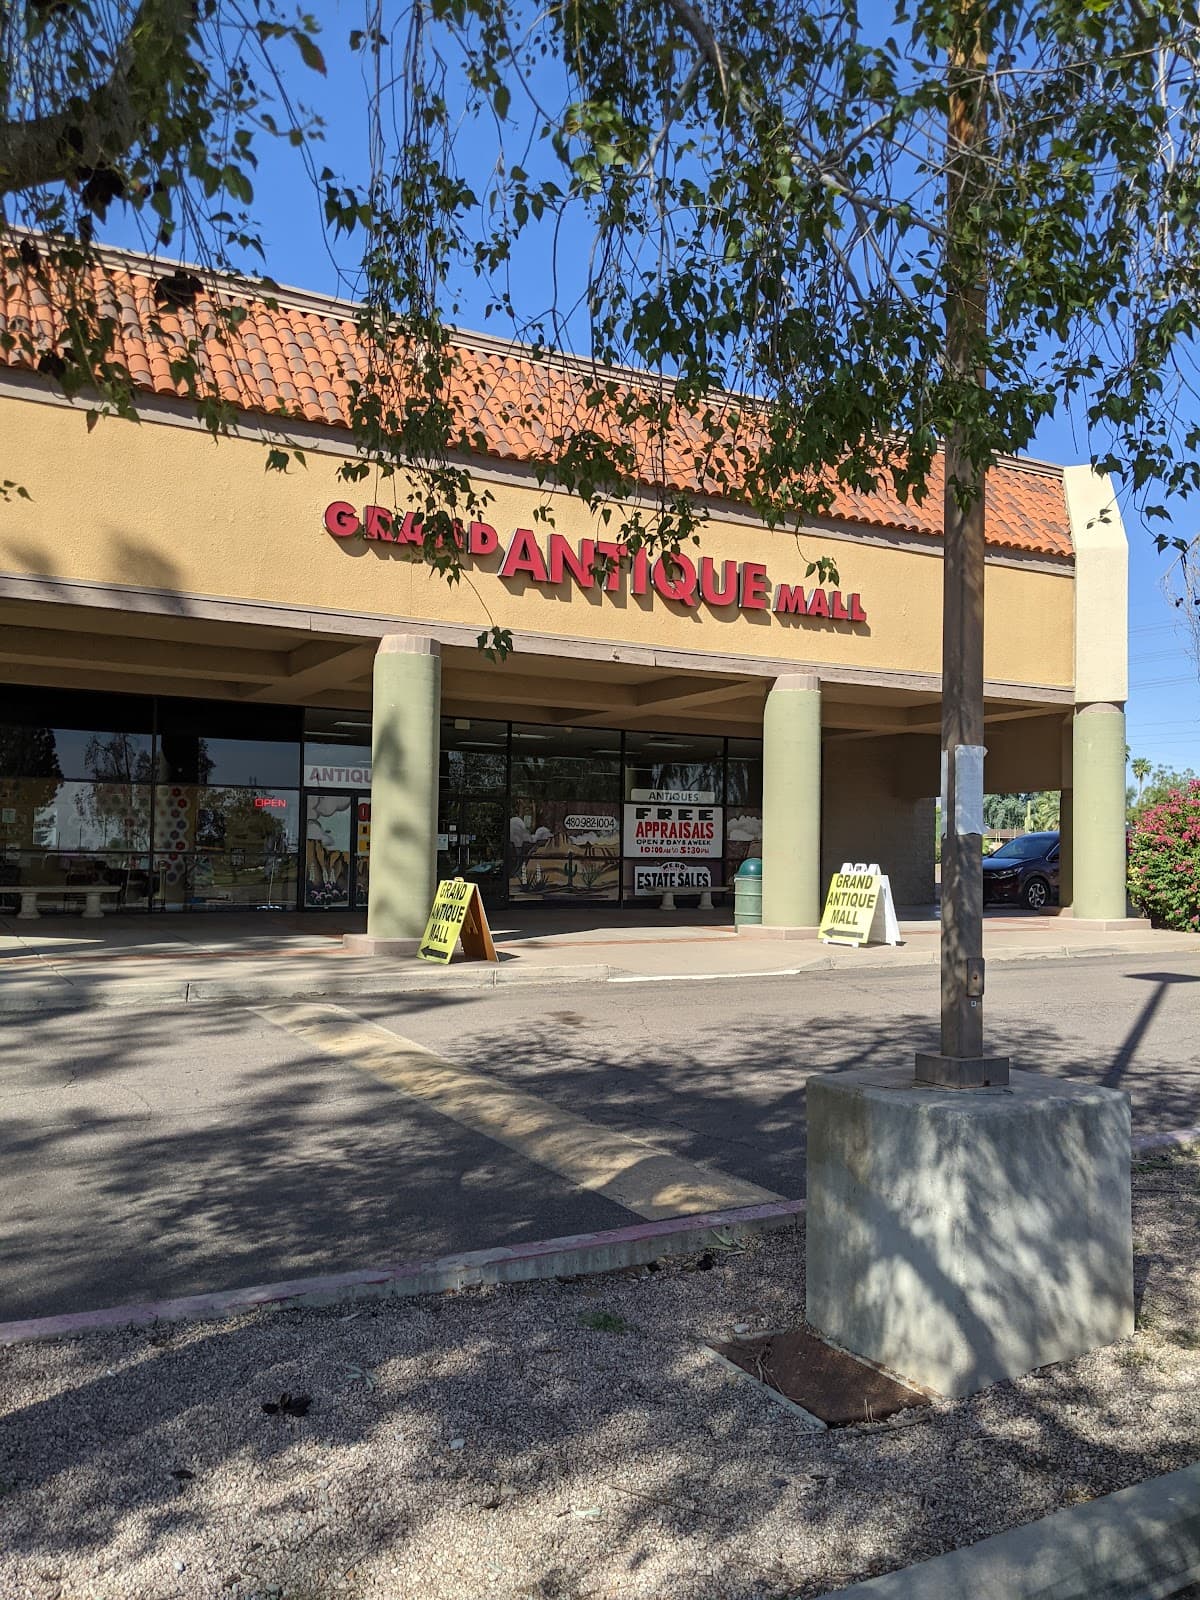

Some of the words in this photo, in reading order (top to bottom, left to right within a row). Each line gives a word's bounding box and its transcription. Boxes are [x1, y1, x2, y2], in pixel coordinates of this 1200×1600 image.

[323, 500, 499, 555] GRAD
[498, 528, 768, 609] ANTIQUE
[773, 583, 868, 622] MALL
[255, 798, 287, 808] OPEN
[648, 791, 699, 801] ANTIQUES
[635, 807, 714, 821] FREE
[635, 821, 714, 839] APPRAISALS
[637, 872, 676, 890] ESTATE
[677, 872, 709, 888] SALES
[835, 873, 873, 890] GRAND
[440, 882, 468, 901] GRAND
[826, 891, 876, 909] ANTIQUE
[431, 903, 465, 923] ANTIQUE
[830, 909, 858, 926] MALL
[428, 923, 449, 944] MALL
